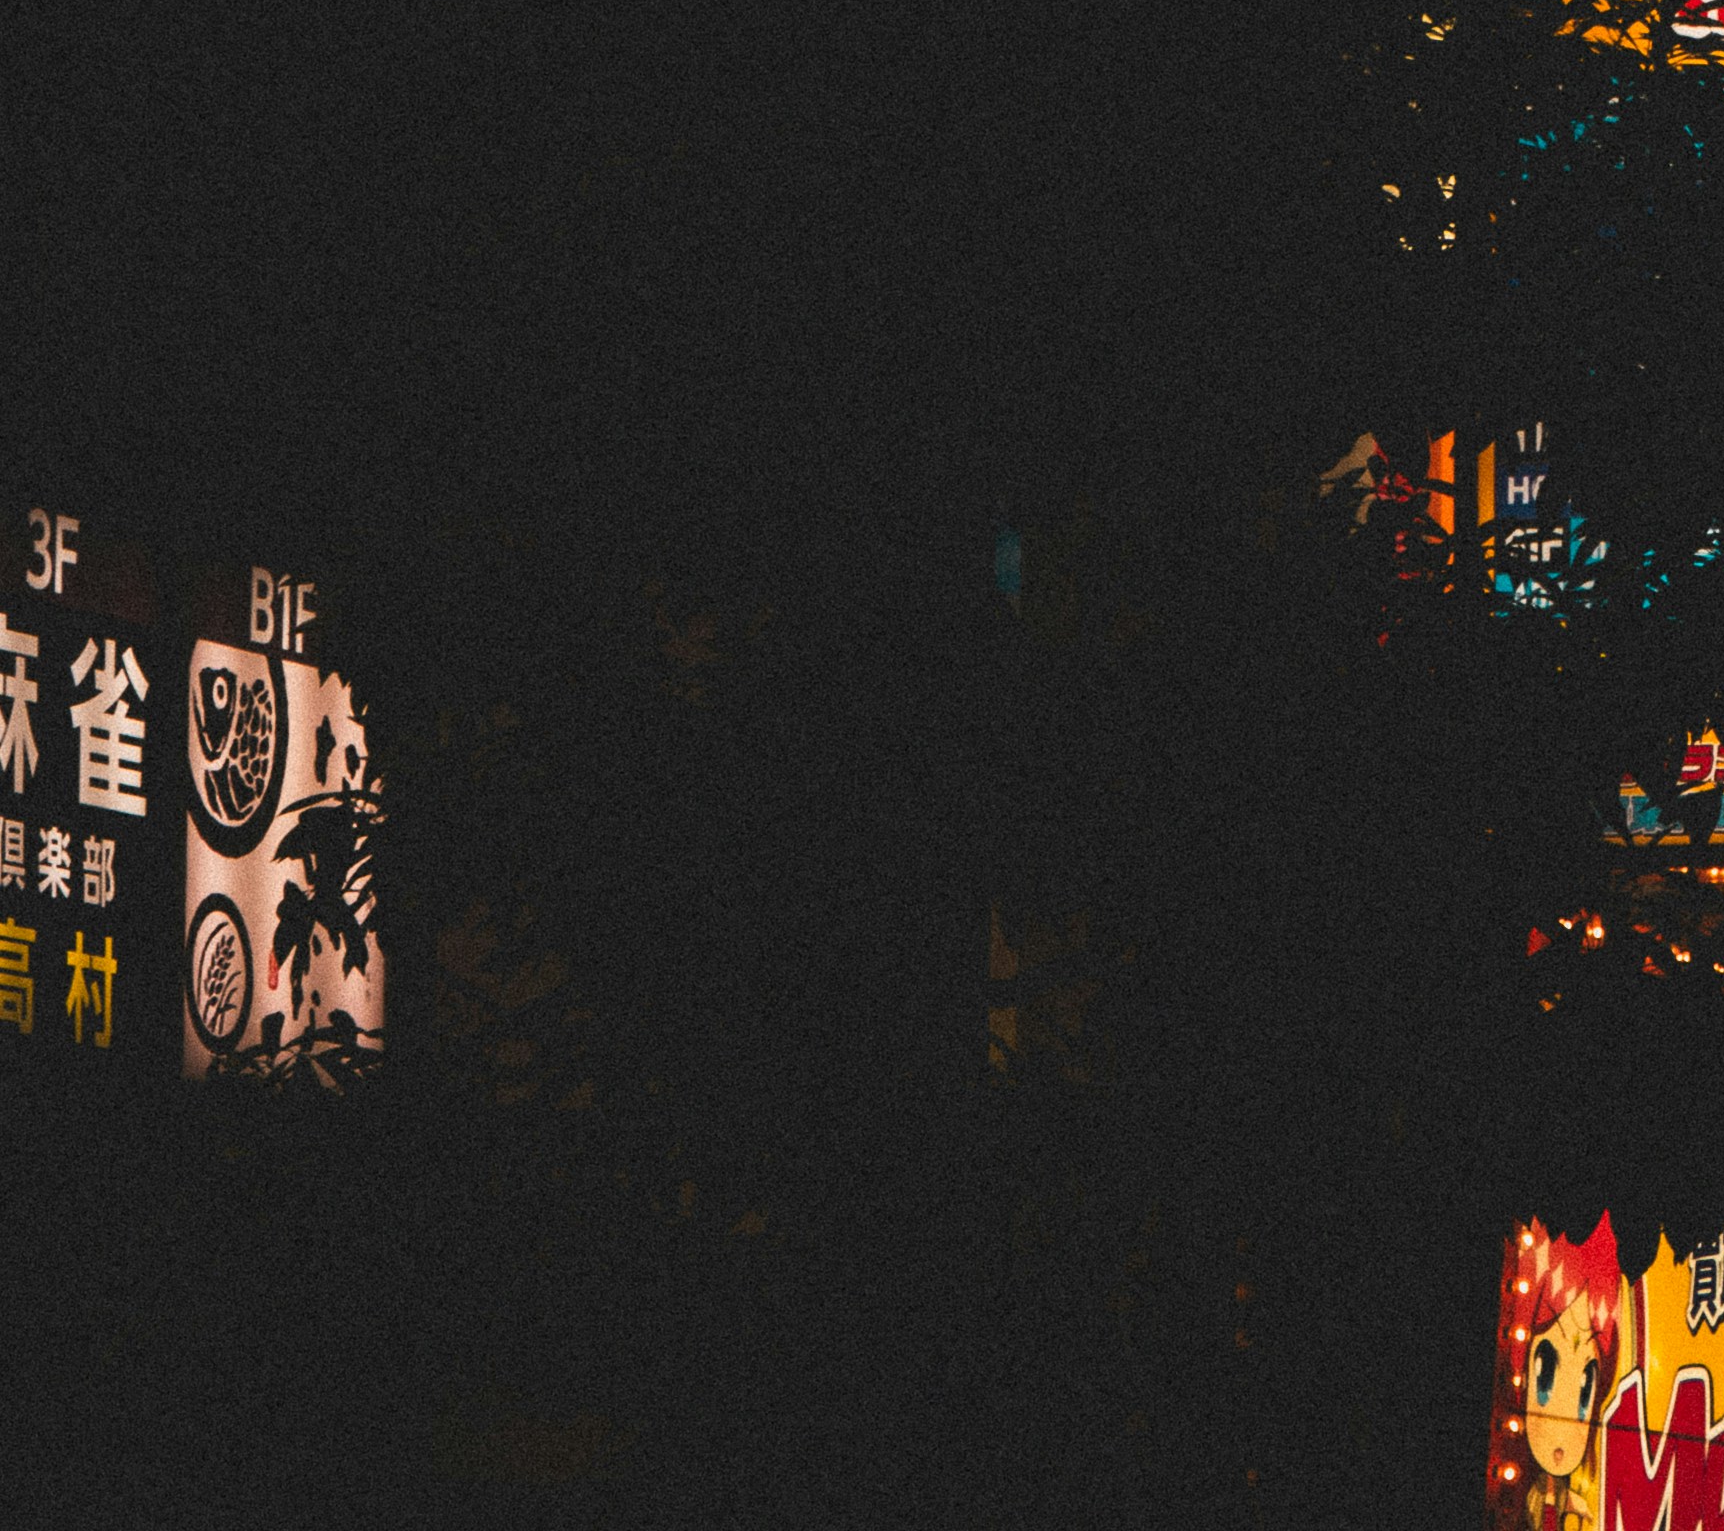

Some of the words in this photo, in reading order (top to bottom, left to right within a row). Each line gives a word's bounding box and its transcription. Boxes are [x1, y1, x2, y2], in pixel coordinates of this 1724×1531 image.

[26, 507, 80, 595] 3F
[249, 566, 317, 654] B1F
[0, 916, 118, 1048] 高村
